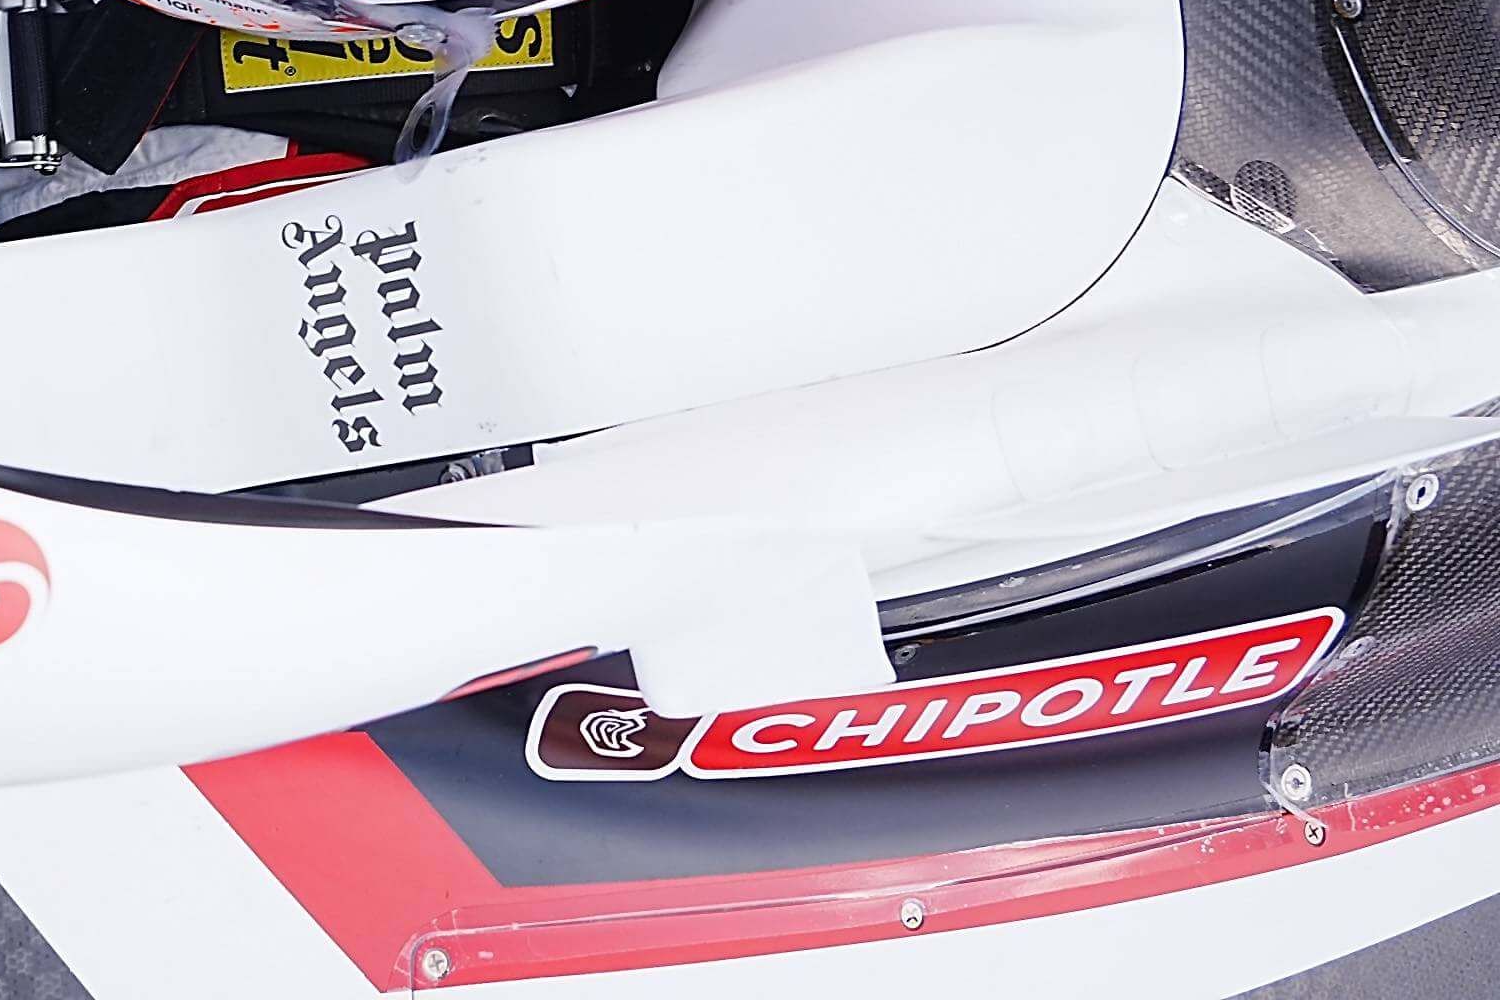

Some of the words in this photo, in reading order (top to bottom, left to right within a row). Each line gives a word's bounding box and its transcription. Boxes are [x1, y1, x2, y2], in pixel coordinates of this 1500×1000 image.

[281, 214, 386, 453] Angels
[349, 220, 444, 416] Palm
[731, 637, 1301, 757] CHIPOTLE
